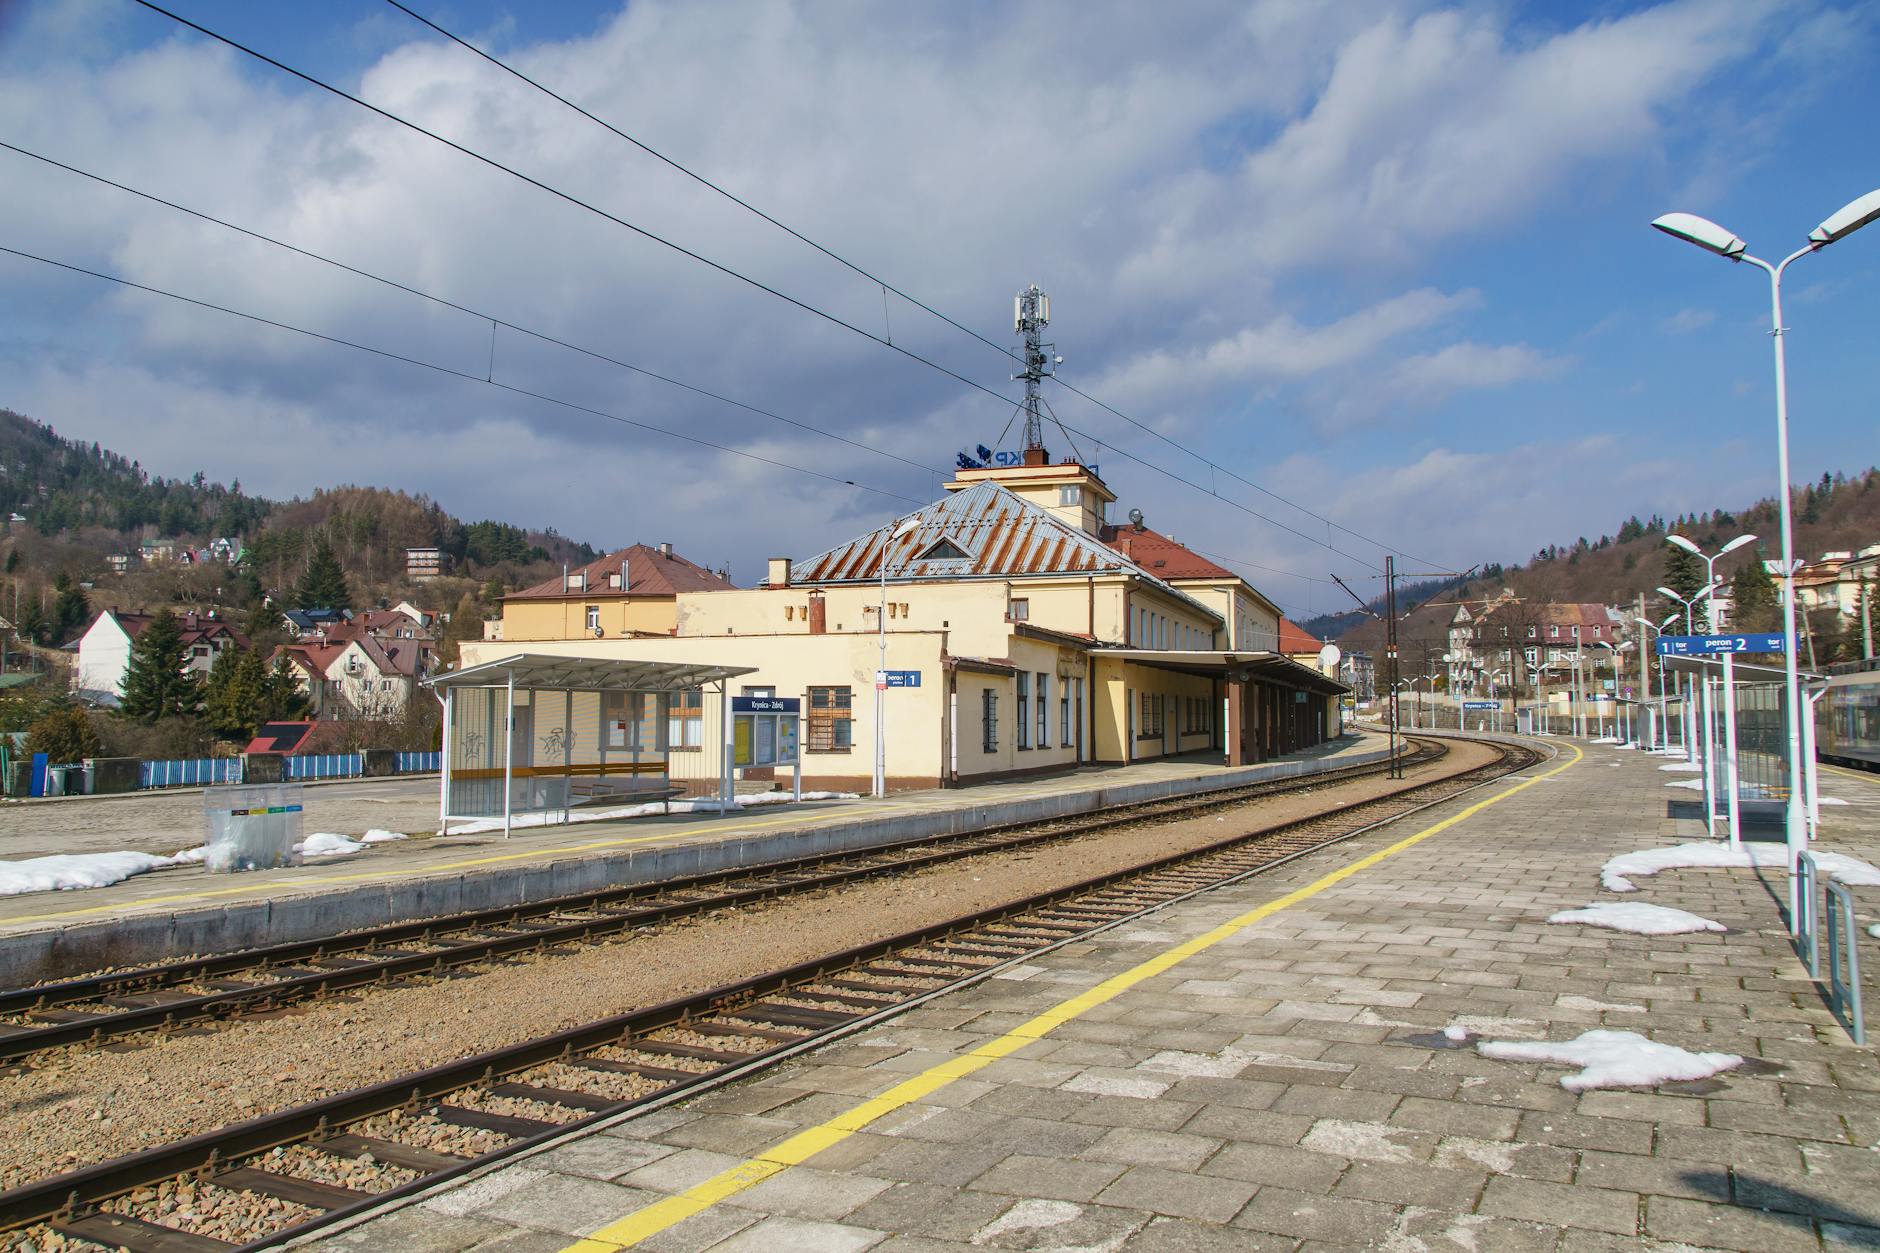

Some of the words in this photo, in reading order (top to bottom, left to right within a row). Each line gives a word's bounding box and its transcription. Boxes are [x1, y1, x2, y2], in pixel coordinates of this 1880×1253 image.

[1661, 642, 1669, 653] 1
[1705, 639, 1732, 648] peron
[1736, 638, 1747, 651] 2
[909, 675, 916, 685] 1
[751, 700, 769, 710] Krynica
